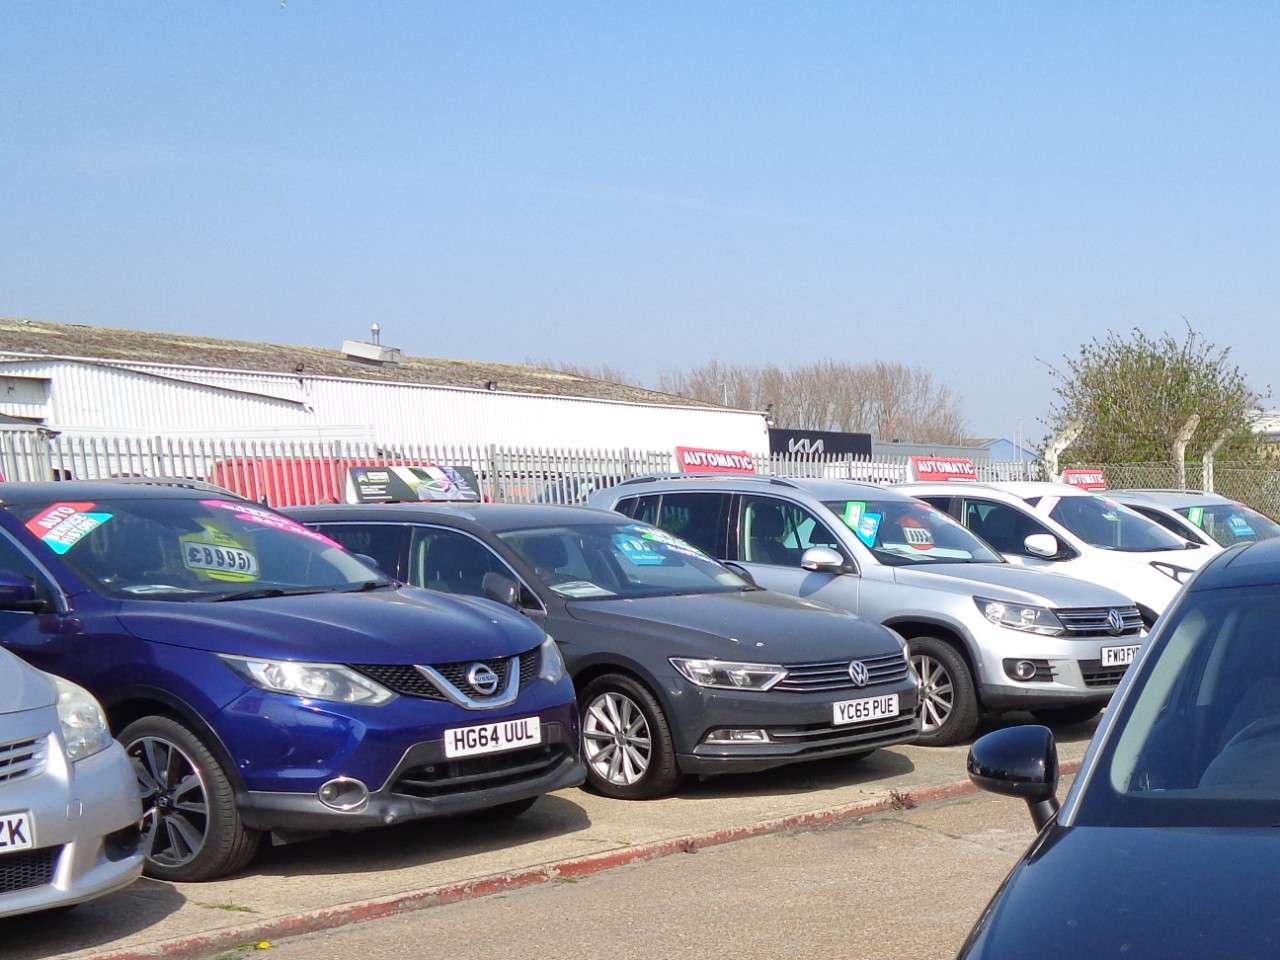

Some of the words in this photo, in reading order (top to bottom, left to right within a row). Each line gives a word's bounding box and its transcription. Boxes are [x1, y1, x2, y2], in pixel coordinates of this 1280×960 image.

[684, 452, 754, 470] AUTOMATIC
[917, 460, 976, 474] AUTOMATIC
[1069, 474, 1105, 484] AUTOMATIC
[37, 506, 76, 529] AUTO
[839, 701, 870, 721] YC65
[873, 698, 894, 716] PUE
[454, 726, 500, 751] HG64
[504, 720, 534, 743] UUL
